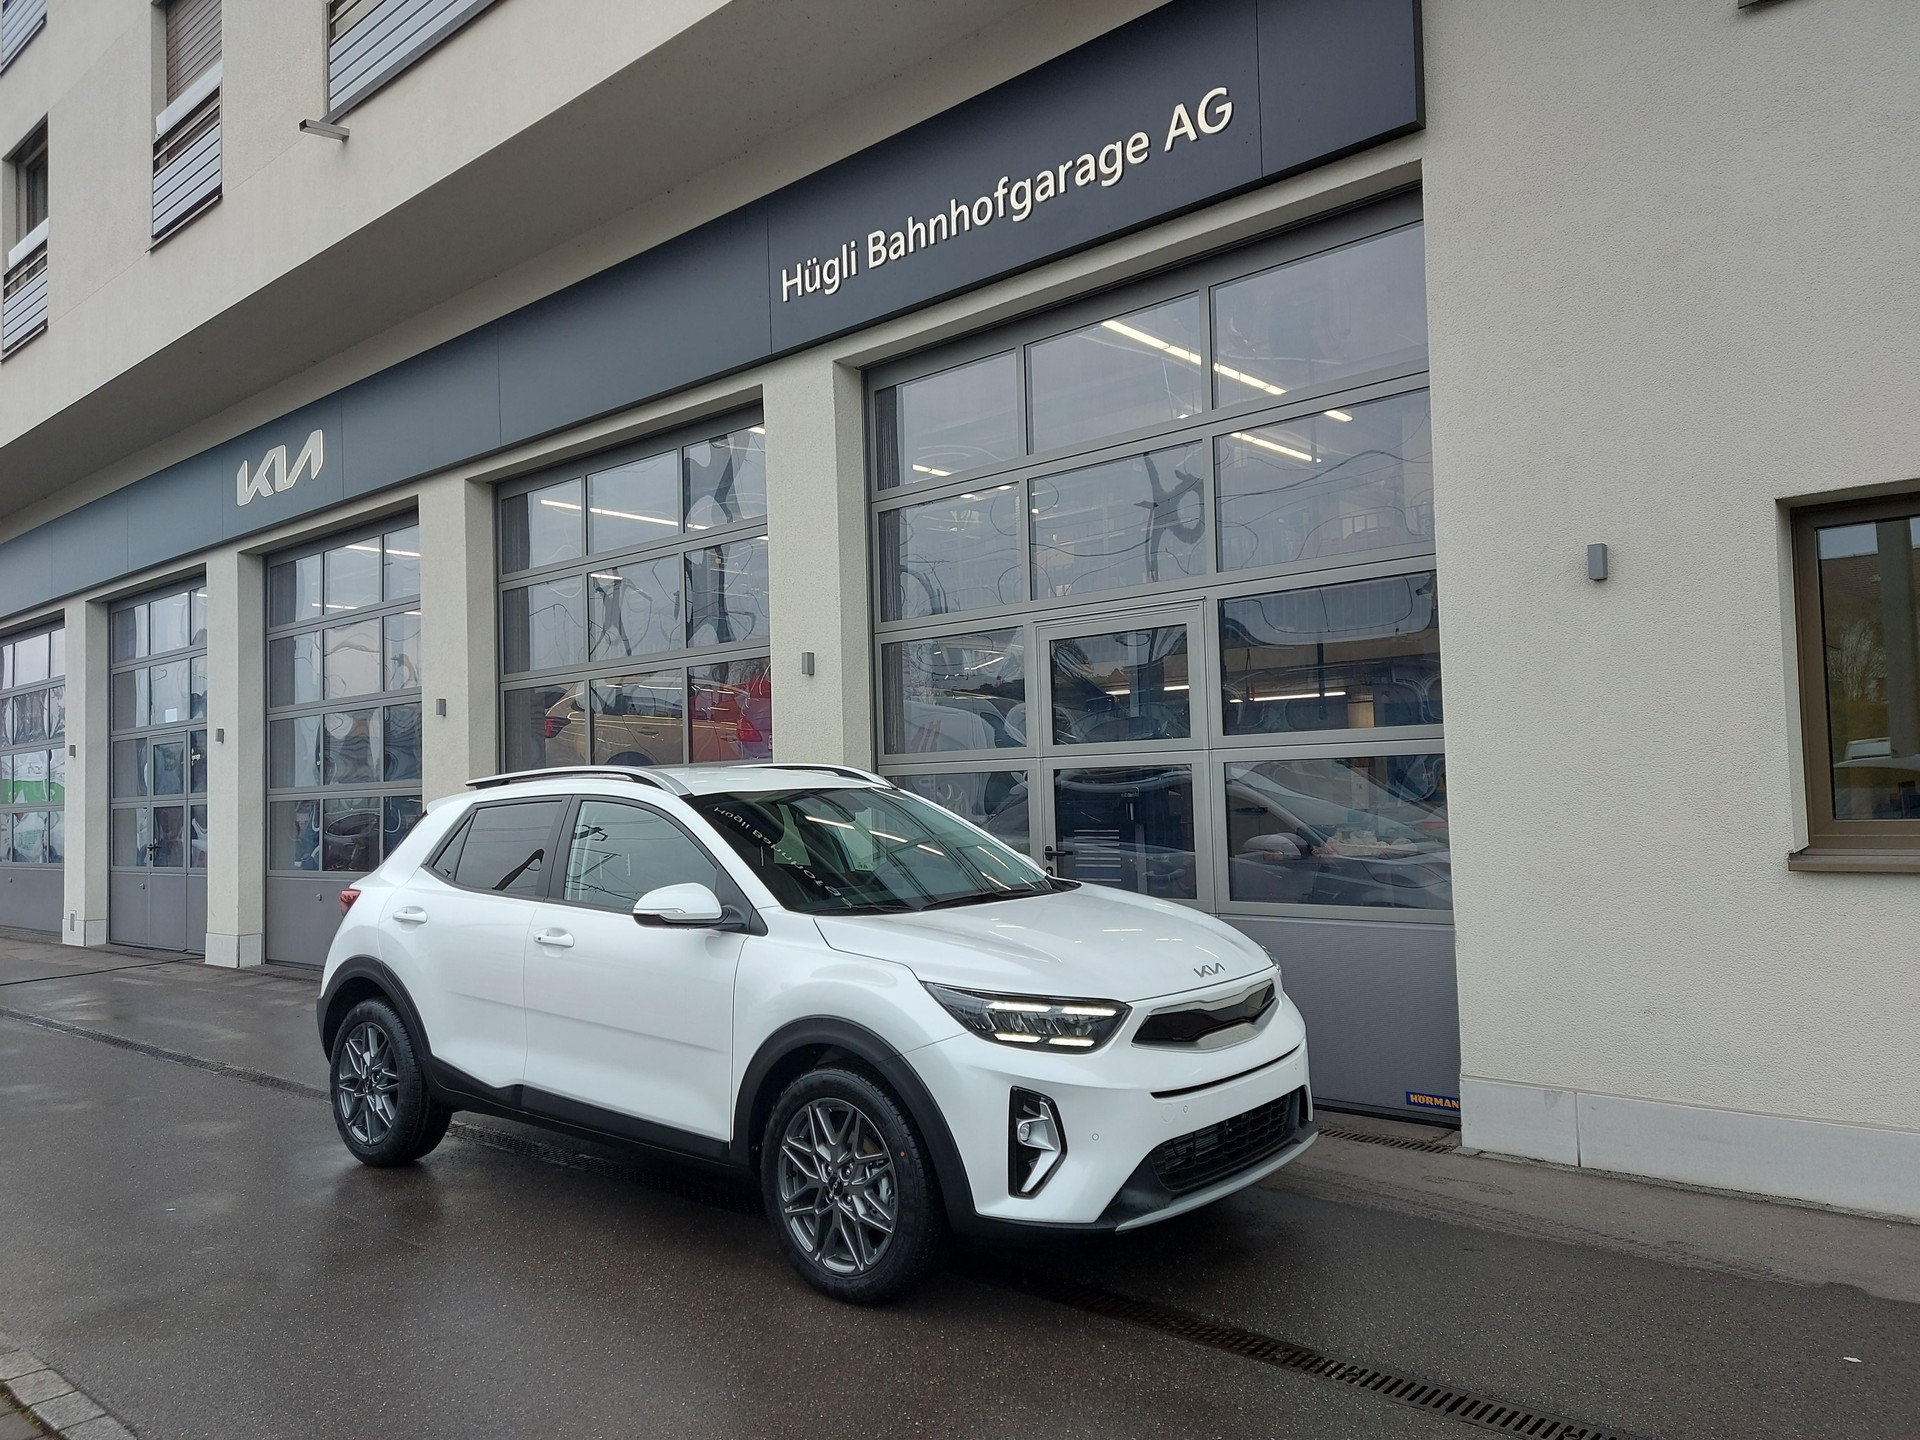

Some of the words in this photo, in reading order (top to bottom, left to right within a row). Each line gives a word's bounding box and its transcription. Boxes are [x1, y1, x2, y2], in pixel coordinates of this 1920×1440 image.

[780, 239, 858, 302] Hügli
[866, 130, 1151, 269] Bahnhofgarage
[1164, 86, 1234, 152] AG
[236, 428, 325, 507] KIA
[1193, 962, 1226, 978] KIA
